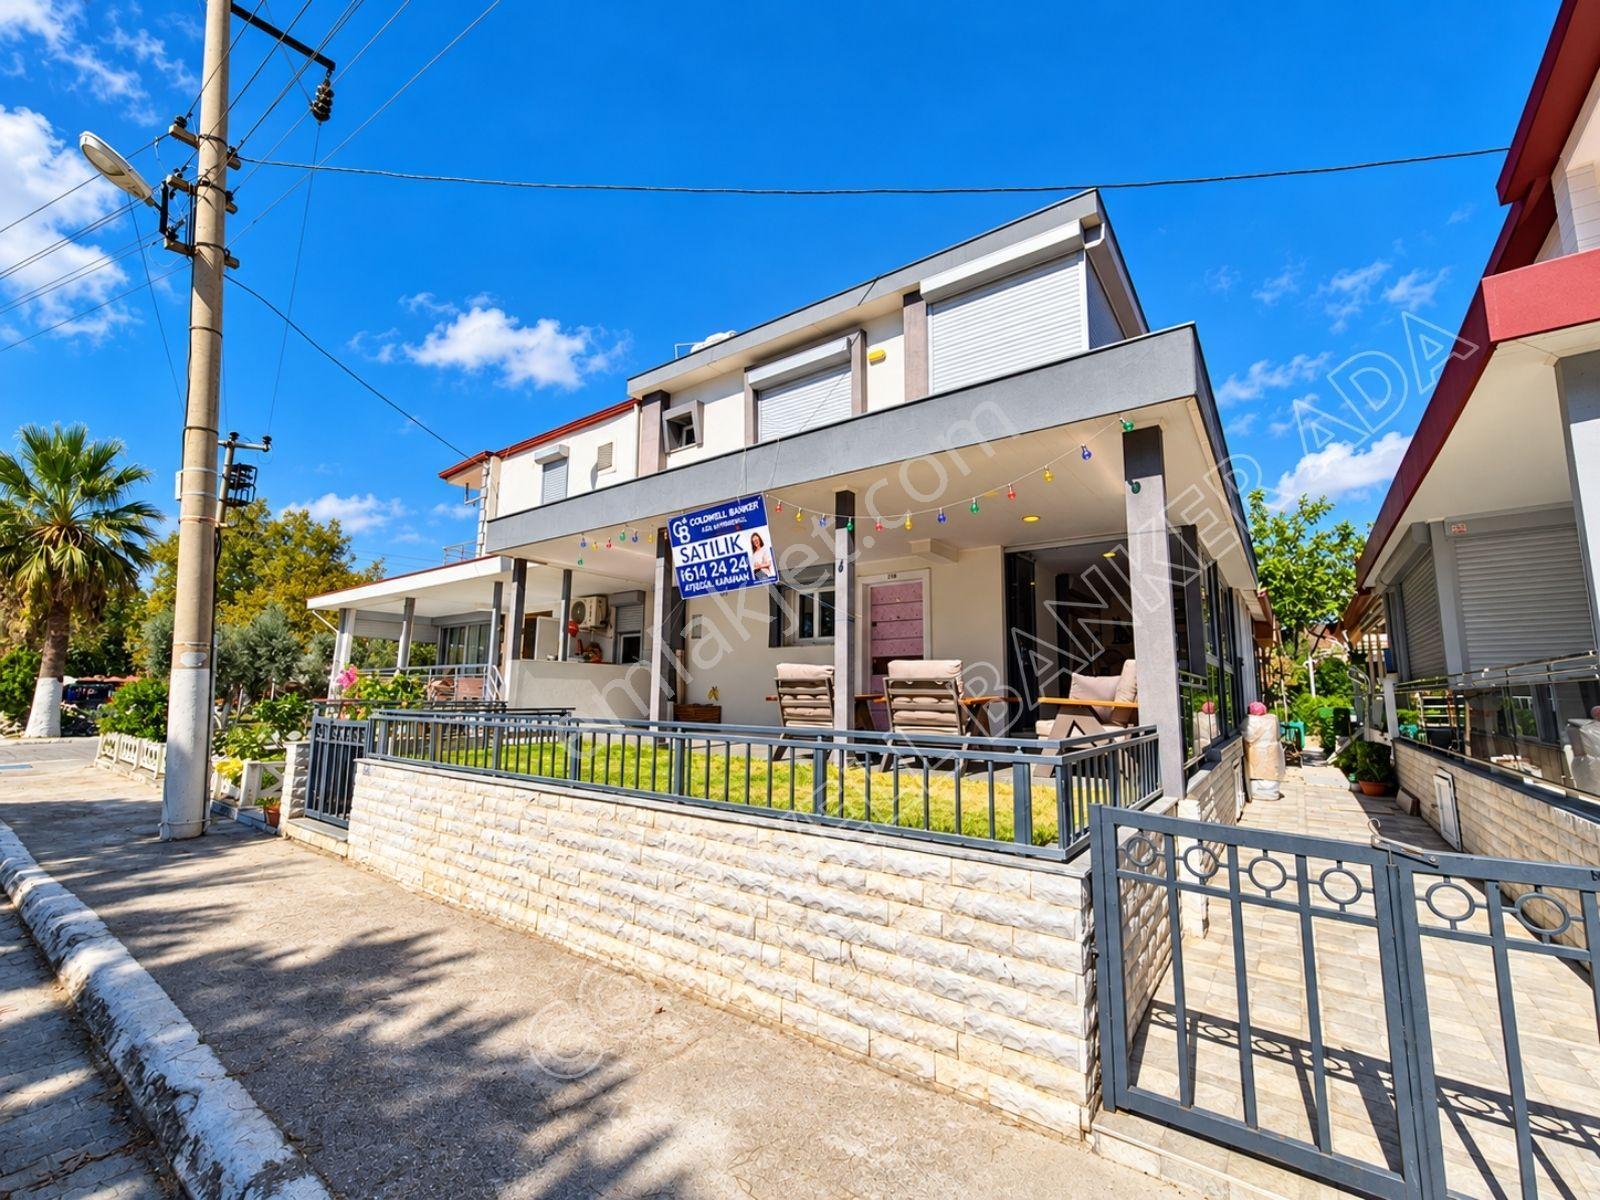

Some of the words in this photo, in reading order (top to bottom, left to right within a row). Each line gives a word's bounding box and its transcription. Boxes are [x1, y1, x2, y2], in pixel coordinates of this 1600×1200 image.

[689, 510, 727, 527] COLDWELL
[728, 500, 759, 517] BANKER
[680, 534, 744, 563] SATILIK
[711, 560, 728, 576] 24
[729, 555, 749, 572] 24
